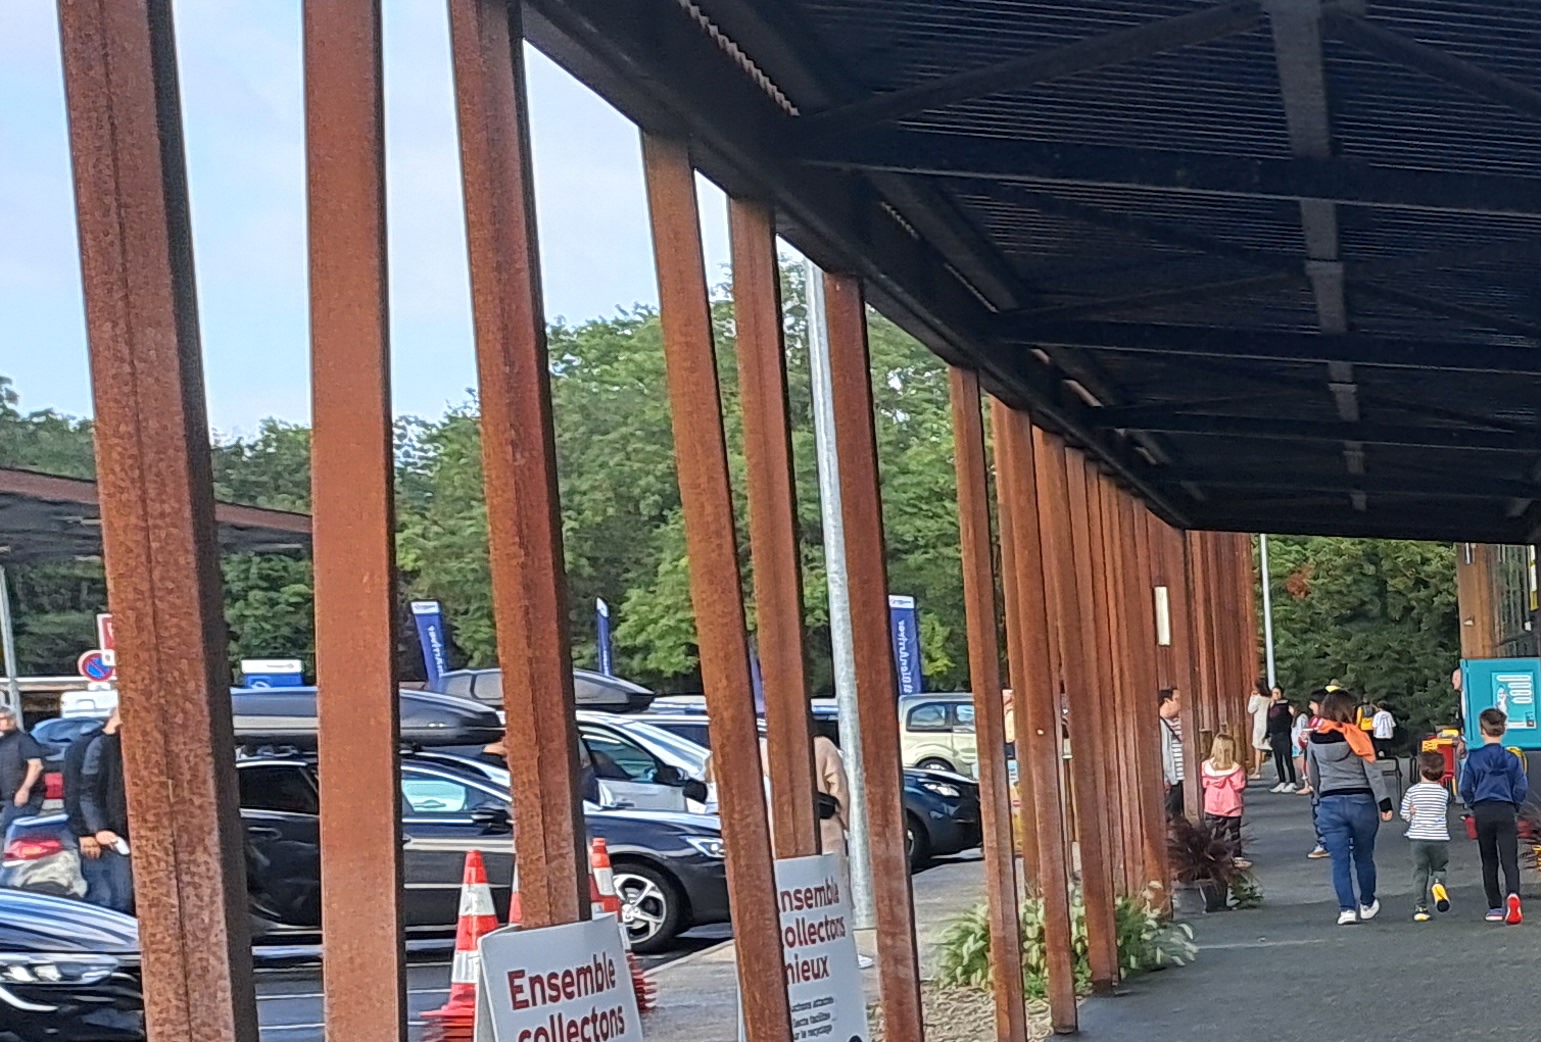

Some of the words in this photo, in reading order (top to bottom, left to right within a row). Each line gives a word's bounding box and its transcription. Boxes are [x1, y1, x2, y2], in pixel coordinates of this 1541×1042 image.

[779, 875, 840, 912] nsemble
[785, 915, 847, 948] ollectons
[507, 952, 616, 1010] Ensemble
